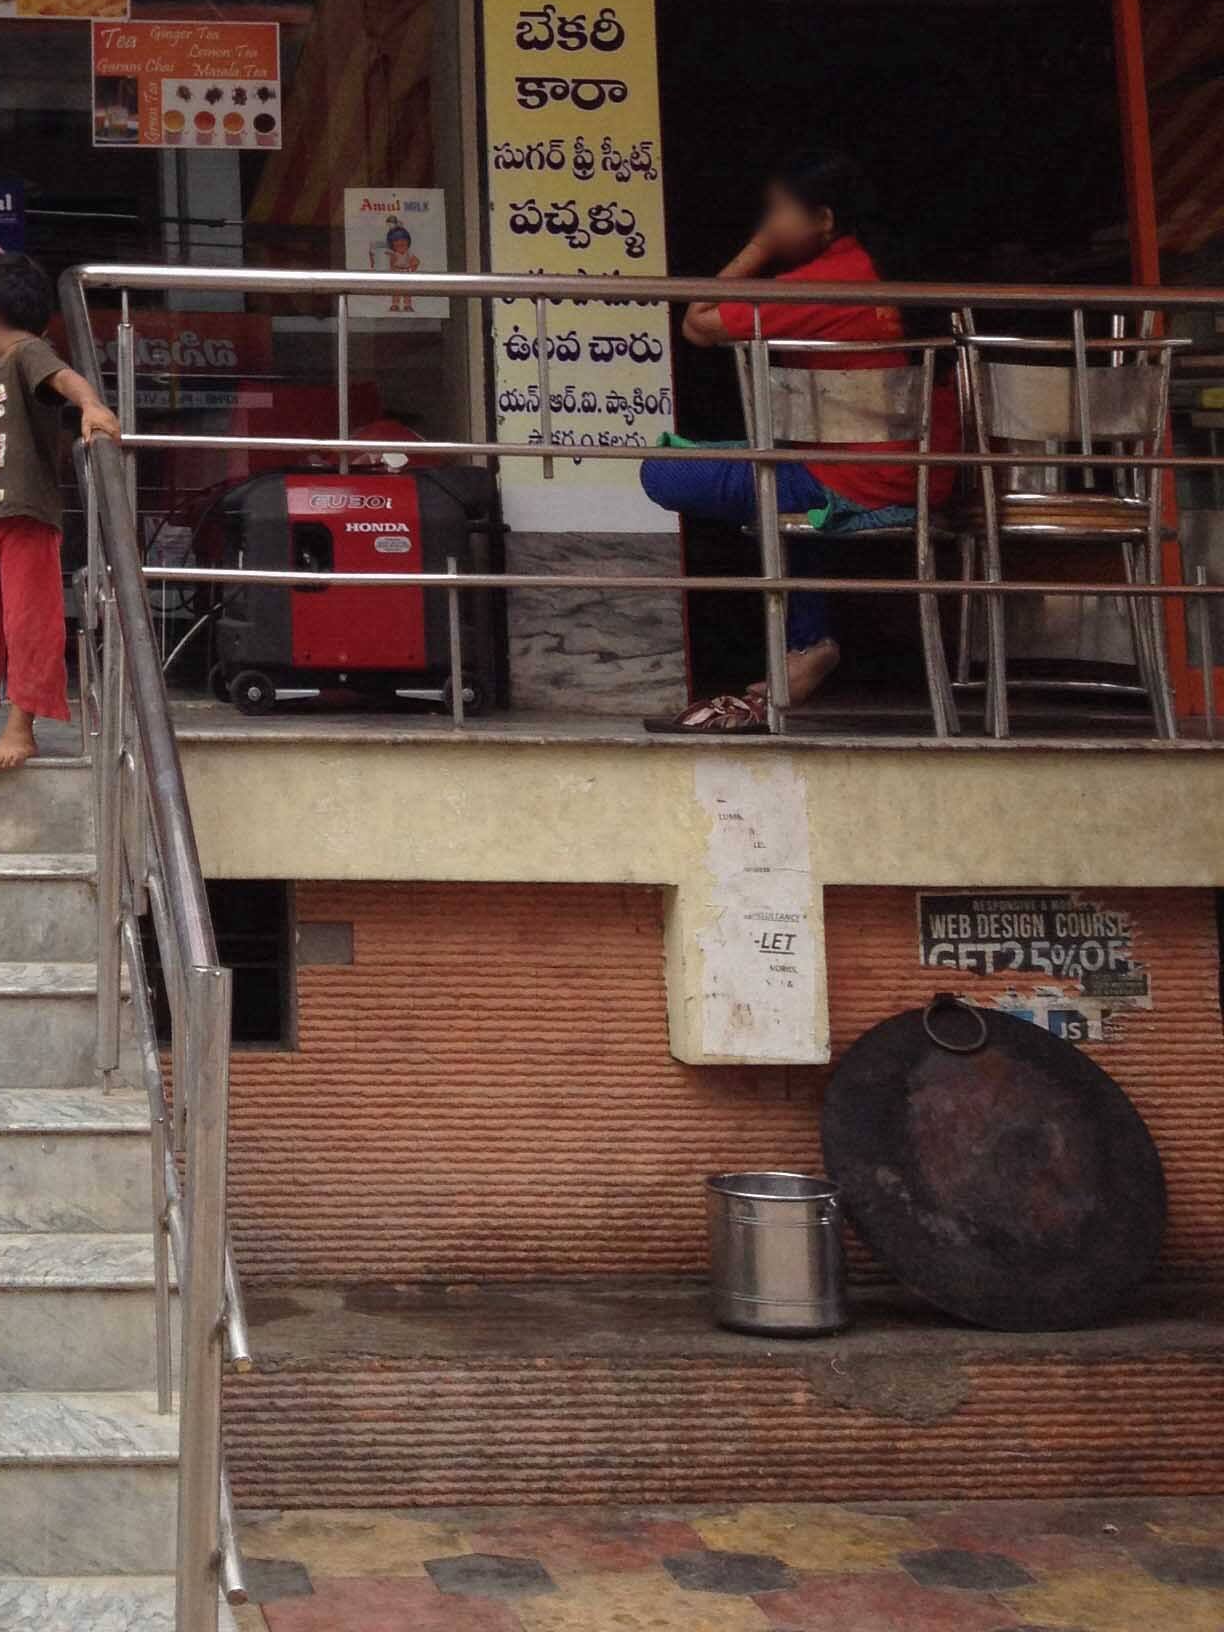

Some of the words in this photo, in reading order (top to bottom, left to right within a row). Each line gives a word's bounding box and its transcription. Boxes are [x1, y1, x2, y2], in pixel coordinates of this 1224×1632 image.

[100, 27, 137, 49] Tea
[494, 139, 566, 171] సుగర్
[589, 332, 663, 363] చారు
[345, 522, 410, 534] HONDA
[929, 913, 971, 939] WEB
[977, 913, 1045, 938] DESIGN
[1056, 912, 1132, 938] COURSE
